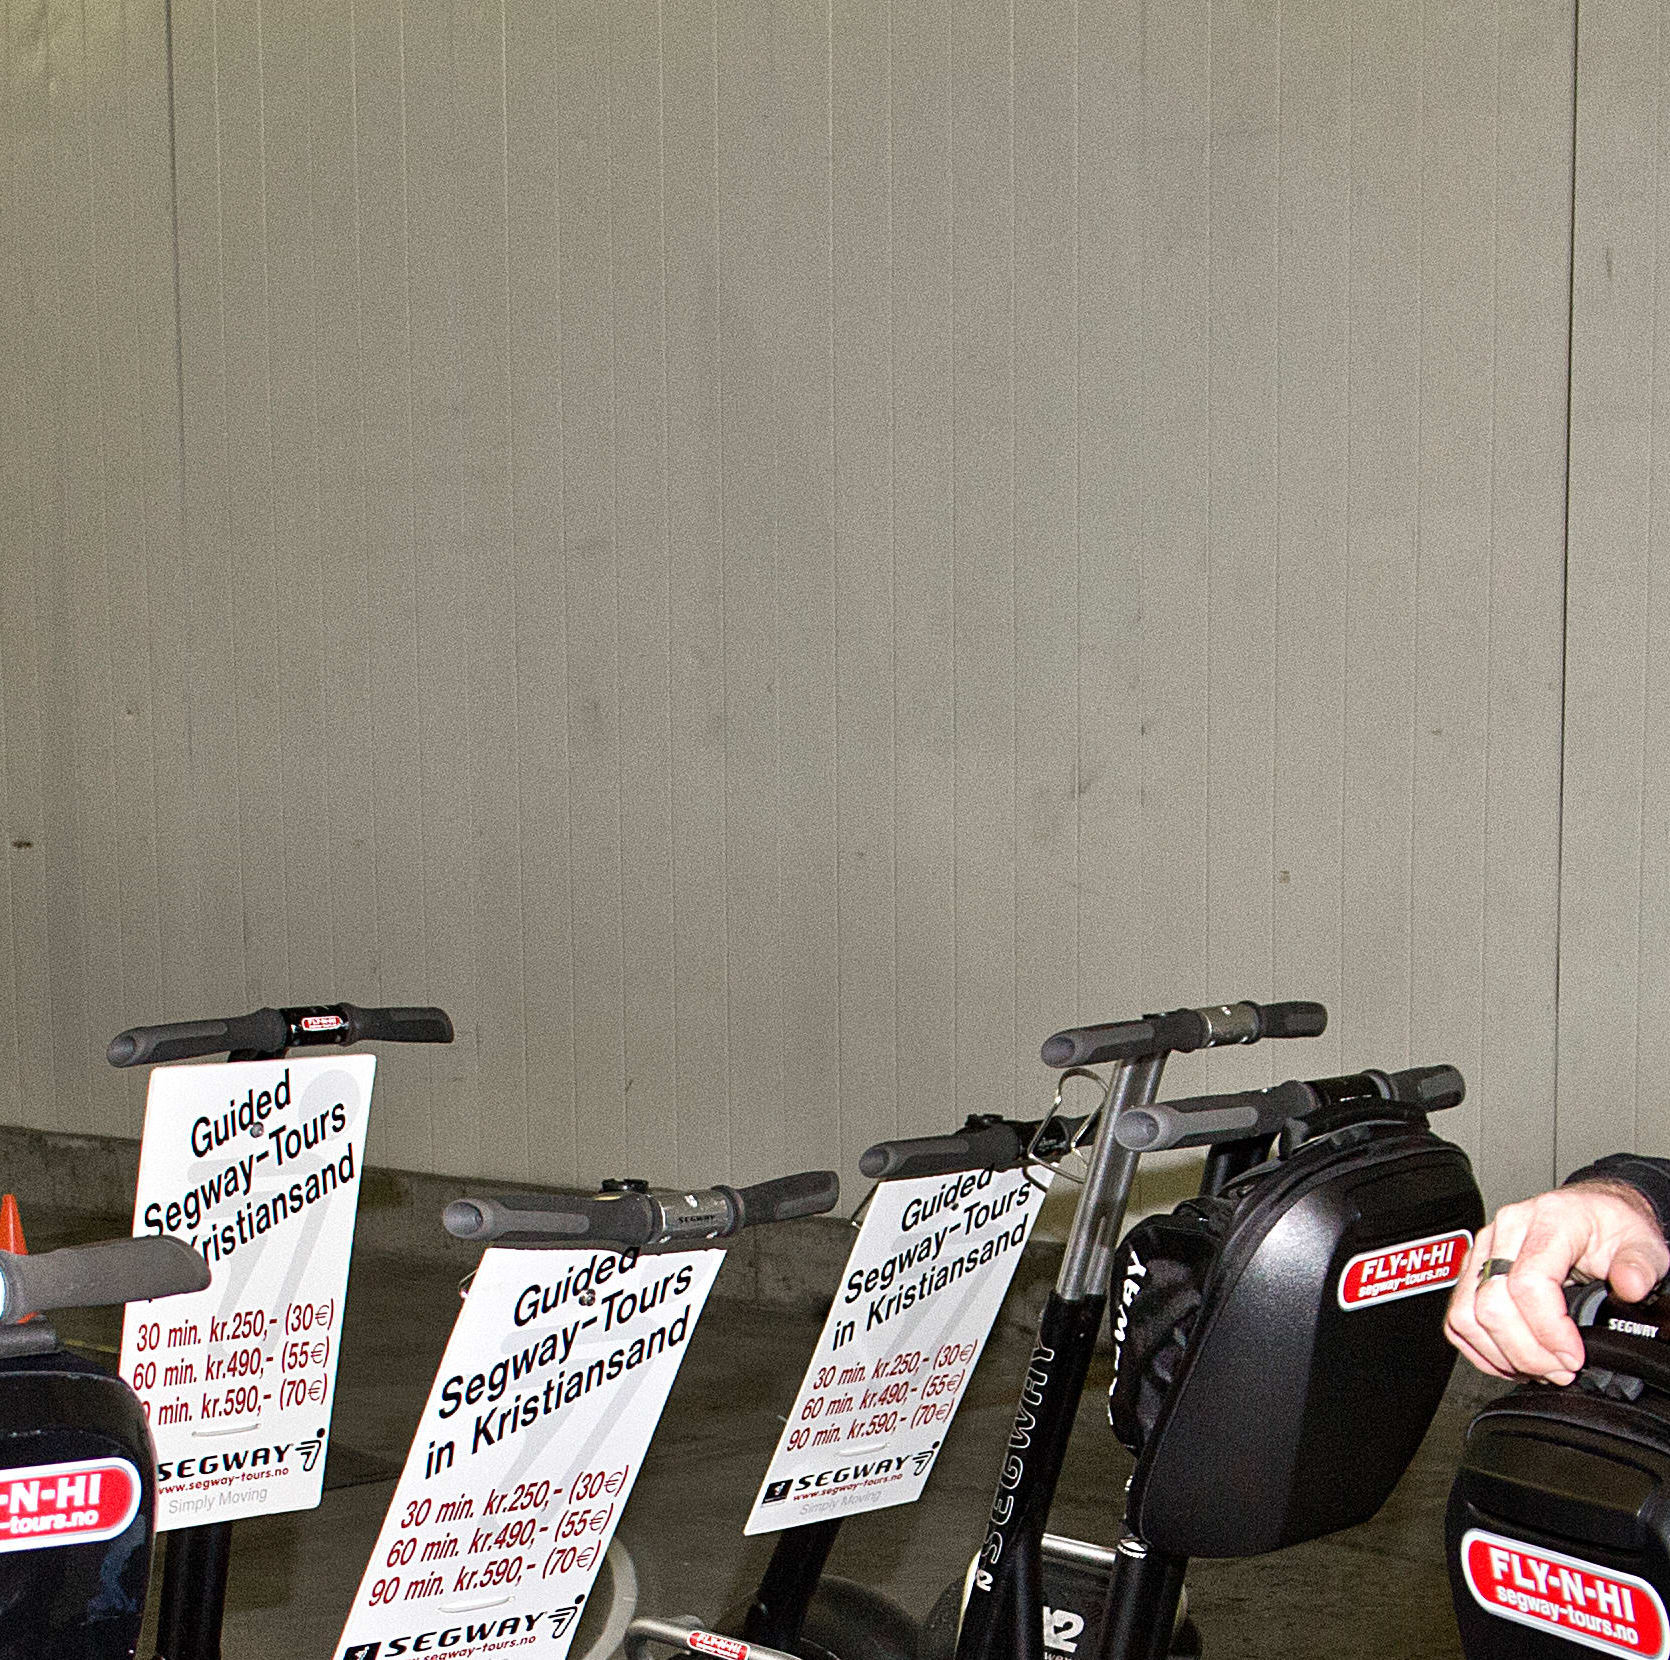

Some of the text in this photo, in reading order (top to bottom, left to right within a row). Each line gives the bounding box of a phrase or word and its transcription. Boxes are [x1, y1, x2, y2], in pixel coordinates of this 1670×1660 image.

[191, 1069, 291, 1158] Guided
[144, 1103, 346, 1236] Segway-Tours
[901, 1164, 995, 1232] Guided
[844, 1181, 1031, 1304] Segway-Tours
[1360, 1241, 1455, 1283] FLY-N-HI
[514, 1247, 640, 1327] Guided
[832, 1213, 1029, 1351] in Kristiansand
[137, 1298, 334, 1352] 30 min. kr.250,- (30€)
[439, 1265, 693, 1419] Segway-Tours
[1608, 1318, 1659, 1338] SEGWAY
[133, 1336, 329, 1391] 60 min. kr.490,- (55€)
[425, 1304, 691, 1479] in Kristiansand
[813, 1339, 978, 1390] 30 min. kr.250,- (30€)
[158, 1397, 193, 1426] min.
[201, 1385, 272, 1419] kr.590,-
[280, 1373, 327, 1411] (70€)
[786, 1398, 955, 1451] 90 min. kr.590,- (70€)
[801, 1369, 965, 1421] 60 min. kr.490,- (55€)
[157, 1444, 291, 1482] SEGWAY
[794, 1454, 912, 1491] SEGWAY
[168, 1487, 268, 1514] Simply Moving
[401, 1465, 629, 1529] 30 min. kr.250,- (30€)
[387, 1503, 614, 1568] 60 min. kr.490,- (55€)
[368, 1539, 601, 1607] 90 min. kr.590,- (70€)
[1489, 1546, 1636, 1623] FLY-N-HI
[384, 1612, 545, 1658] SEGWAY
[1496, 1585, 1639, 1645] segway-tours.no
